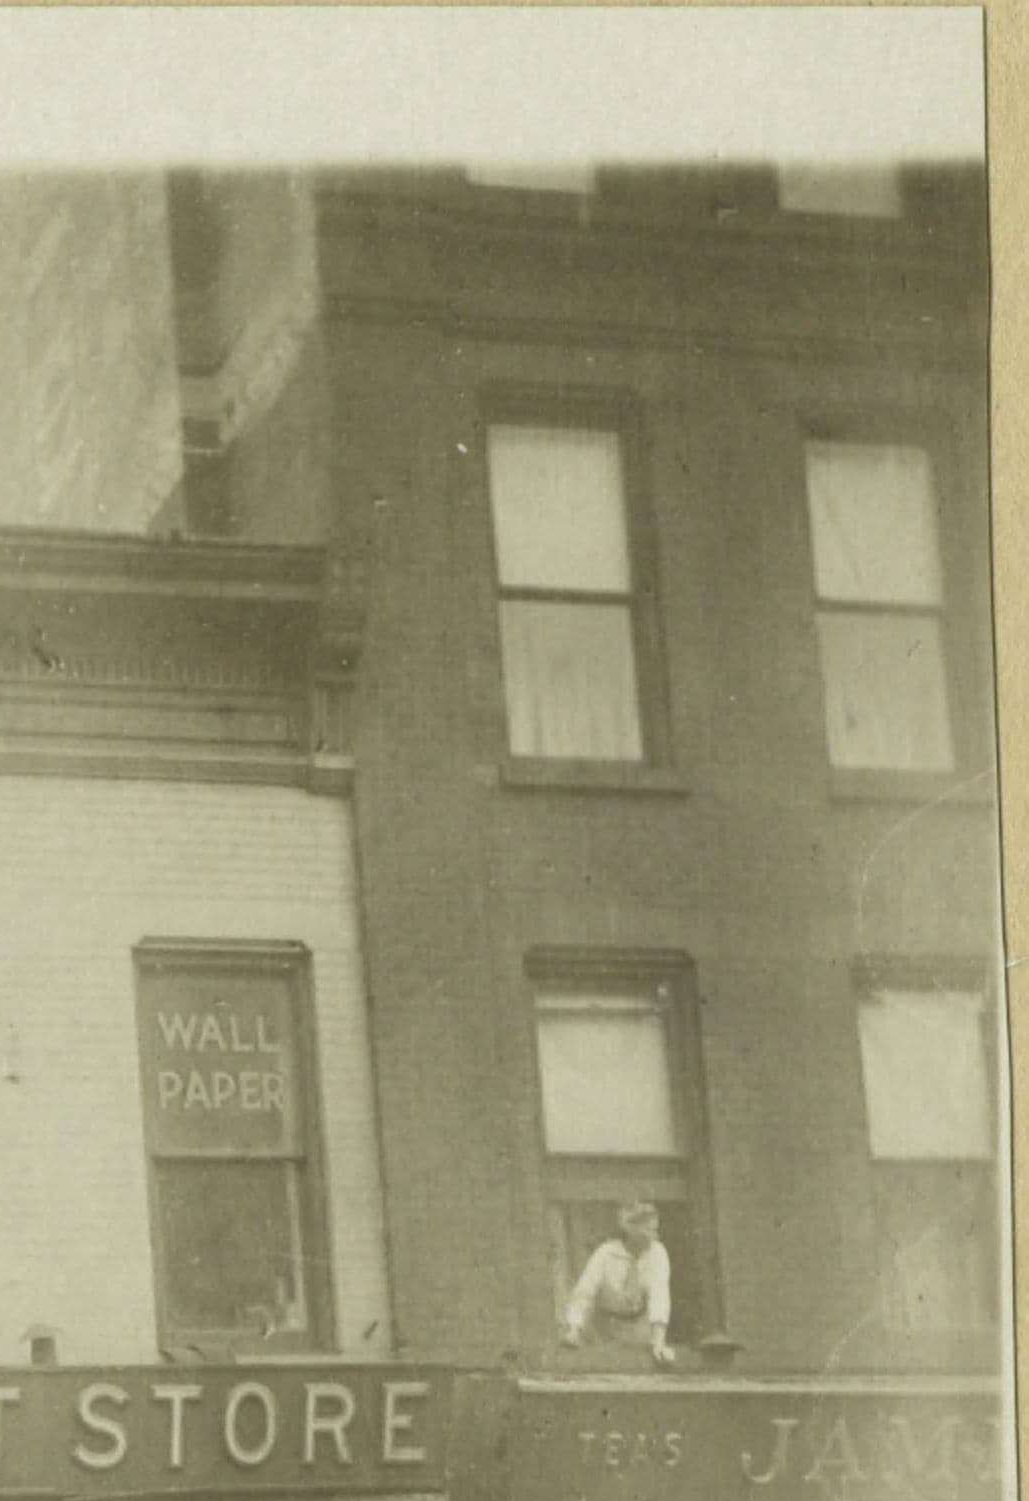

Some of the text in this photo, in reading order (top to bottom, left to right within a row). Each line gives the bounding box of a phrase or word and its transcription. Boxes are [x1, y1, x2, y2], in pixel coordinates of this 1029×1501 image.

[155, 1011, 283, 1055] WALL
[155, 1070, 288, 1110] PAPER
[72, 1381, 432, 1471] STORE
